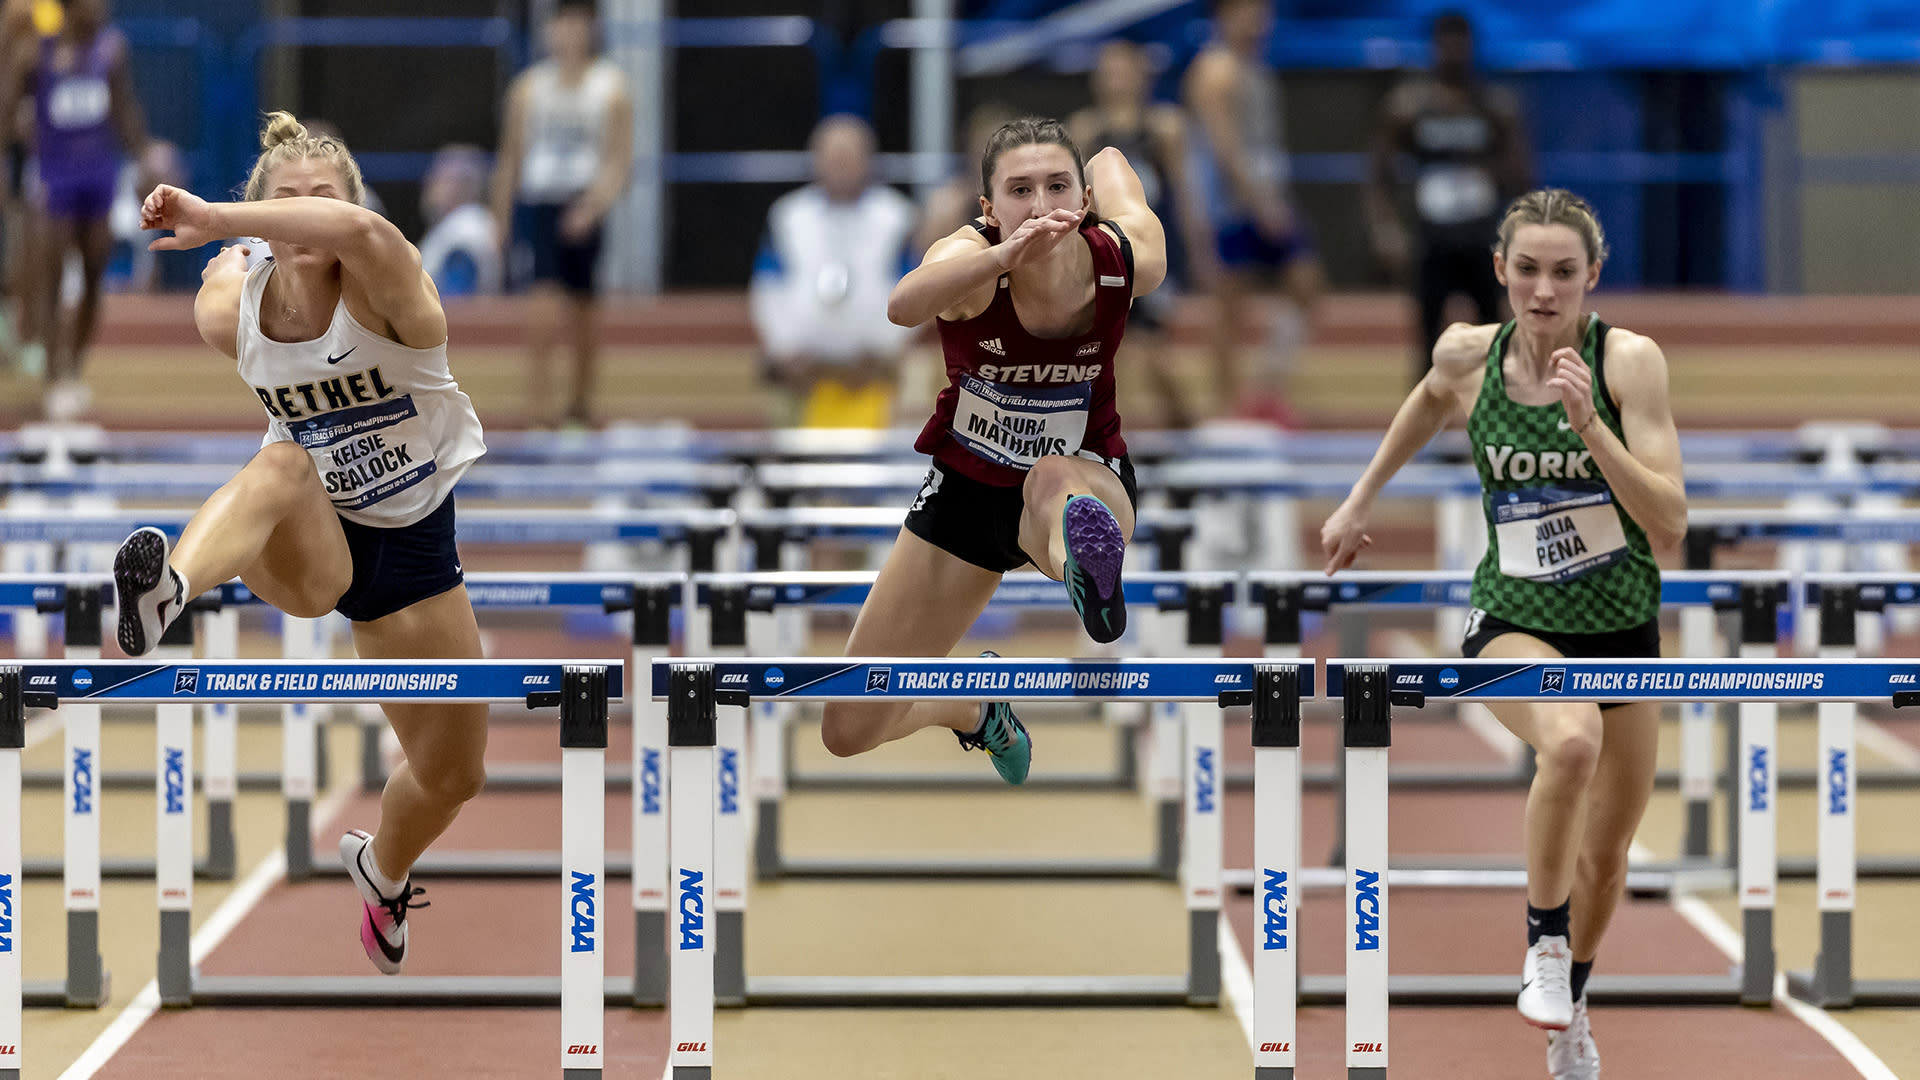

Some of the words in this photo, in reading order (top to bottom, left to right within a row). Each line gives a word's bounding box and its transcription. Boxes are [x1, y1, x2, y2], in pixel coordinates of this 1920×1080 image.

[979, 341, 1006, 356] adidas
[1077, 345, 1098, 355] MAC
[978, 363, 1102, 383] STEVENS
[254, 364, 396, 419] BETHEL
[982, 386, 1001, 403] TRACK
[1007, 398, 1027, 406] FIELD
[1027, 397, 1085, 408] CHAMPIONSHIPS
[334, 425, 353, 436] FIELD
[353, 408, 410, 430] CHAMPIONSHIPS
[994, 409, 1046, 436] LAURA
[967, 413, 1067, 459] MATHEWS
[331, 433, 386, 467] KELSIE
[325, 442, 413, 494] SEALOCK
[1484, 445, 1593, 481] YORK
[1536, 515, 1576, 541] JULIA
[1537, 535, 1588, 568] PENA
[29, 675, 57, 685] GILL
[206, 673, 258, 691] TRACK
[259, 673, 272, 691] &
[273, 673, 318, 691] FIELD
[321, 673, 459, 691] CHAMPIONSHIPS
[522, 675, 550, 685] GILL
[721, 674, 749, 683] GILL
[898, 672, 950, 689] TRACK
[951, 672, 964, 689] &
[965, 672, 1010, 689] FIELD
[1013, 672, 1150, 689] CHAMPIONSHIPS
[1214, 674, 1242, 683] GILL
[1396, 674, 1424, 684] GILL
[1571, 672, 1623, 690] TRACK
[1625, 672, 1638, 690] &
[1639, 672, 1685, 690] FIELD
[1687, 672, 1825, 690] CHAMPIONSHIPS
[1888, 674, 1916, 684] GILL
[73, 746, 92, 815] NCAA
[640, 747, 660, 815] NCAA
[571, 870, 595, 953] NCAA
[680, 868, 704, 951] NCAA
[1263, 868, 1288, 951] NCAA
[1355, 868, 1380, 951] NCAA
[567, 1044, 597, 1055] GILL
[676, 1042, 707, 1053] GILL
[1259, 1042, 1290, 1053] GILL
